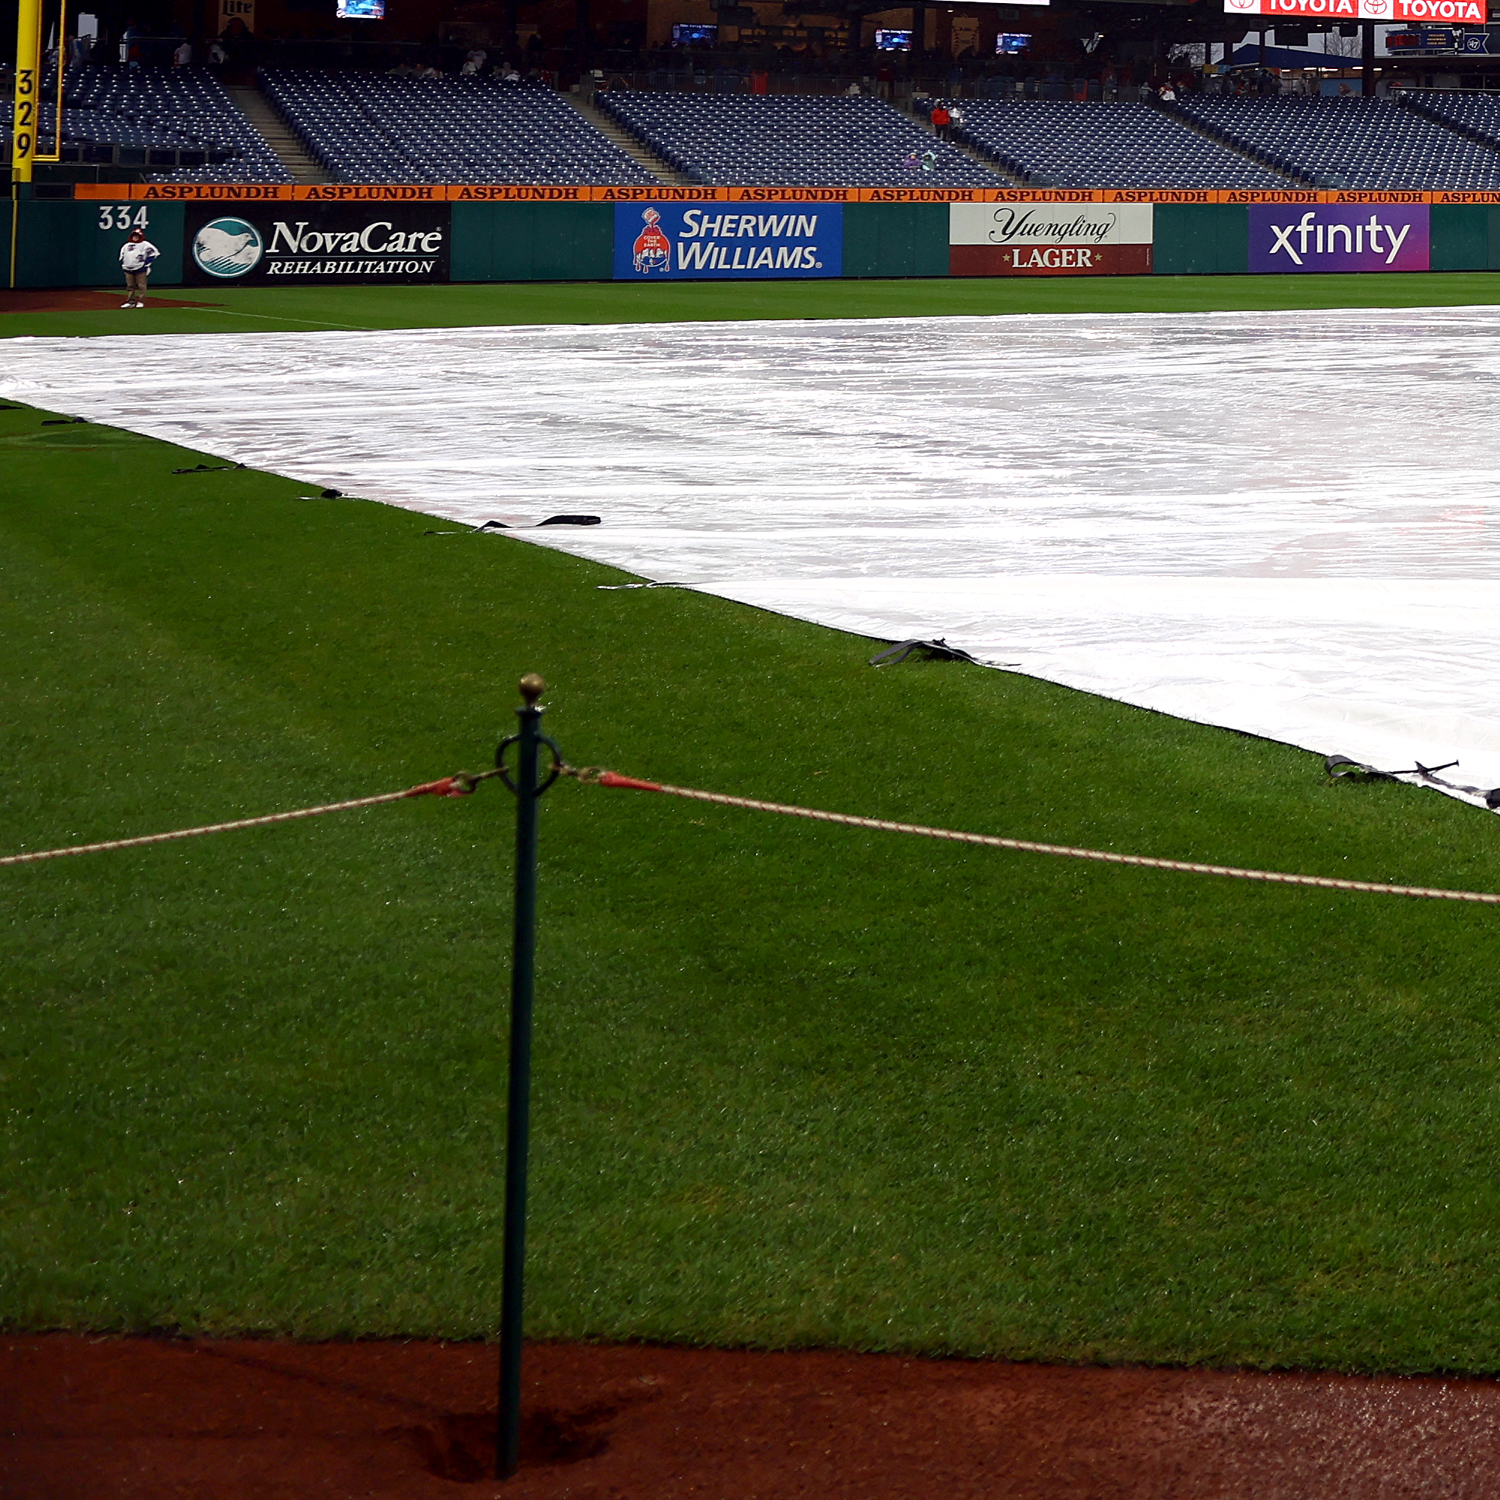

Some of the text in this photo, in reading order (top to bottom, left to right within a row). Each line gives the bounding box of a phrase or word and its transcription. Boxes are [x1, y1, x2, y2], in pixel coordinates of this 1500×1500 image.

[144, 185, 280, 199] ASPLUNDH
[304, 186, 434, 200] ASPLUNDH
[459, 187, 579, 200] ASPLUNDH
[602, 188, 718, 200] ASPLUNDH
[739, 188, 849, 201] ASPLUNDH
[869, 189, 974, 201] ASPLUNDH
[994, 190, 1094, 202] ASPLUNDH
[99, 205, 149, 231] 334
[679, 209, 817, 238] SHERWIN
[989, 207, 1116, 244] Yuengling
[266, 221, 442, 254] NovaCare
[1269, 211, 1411, 265] xfinity
[1012, 248, 1093, 268] LAGER
[266, 260, 435, 275] REHABILITATION
